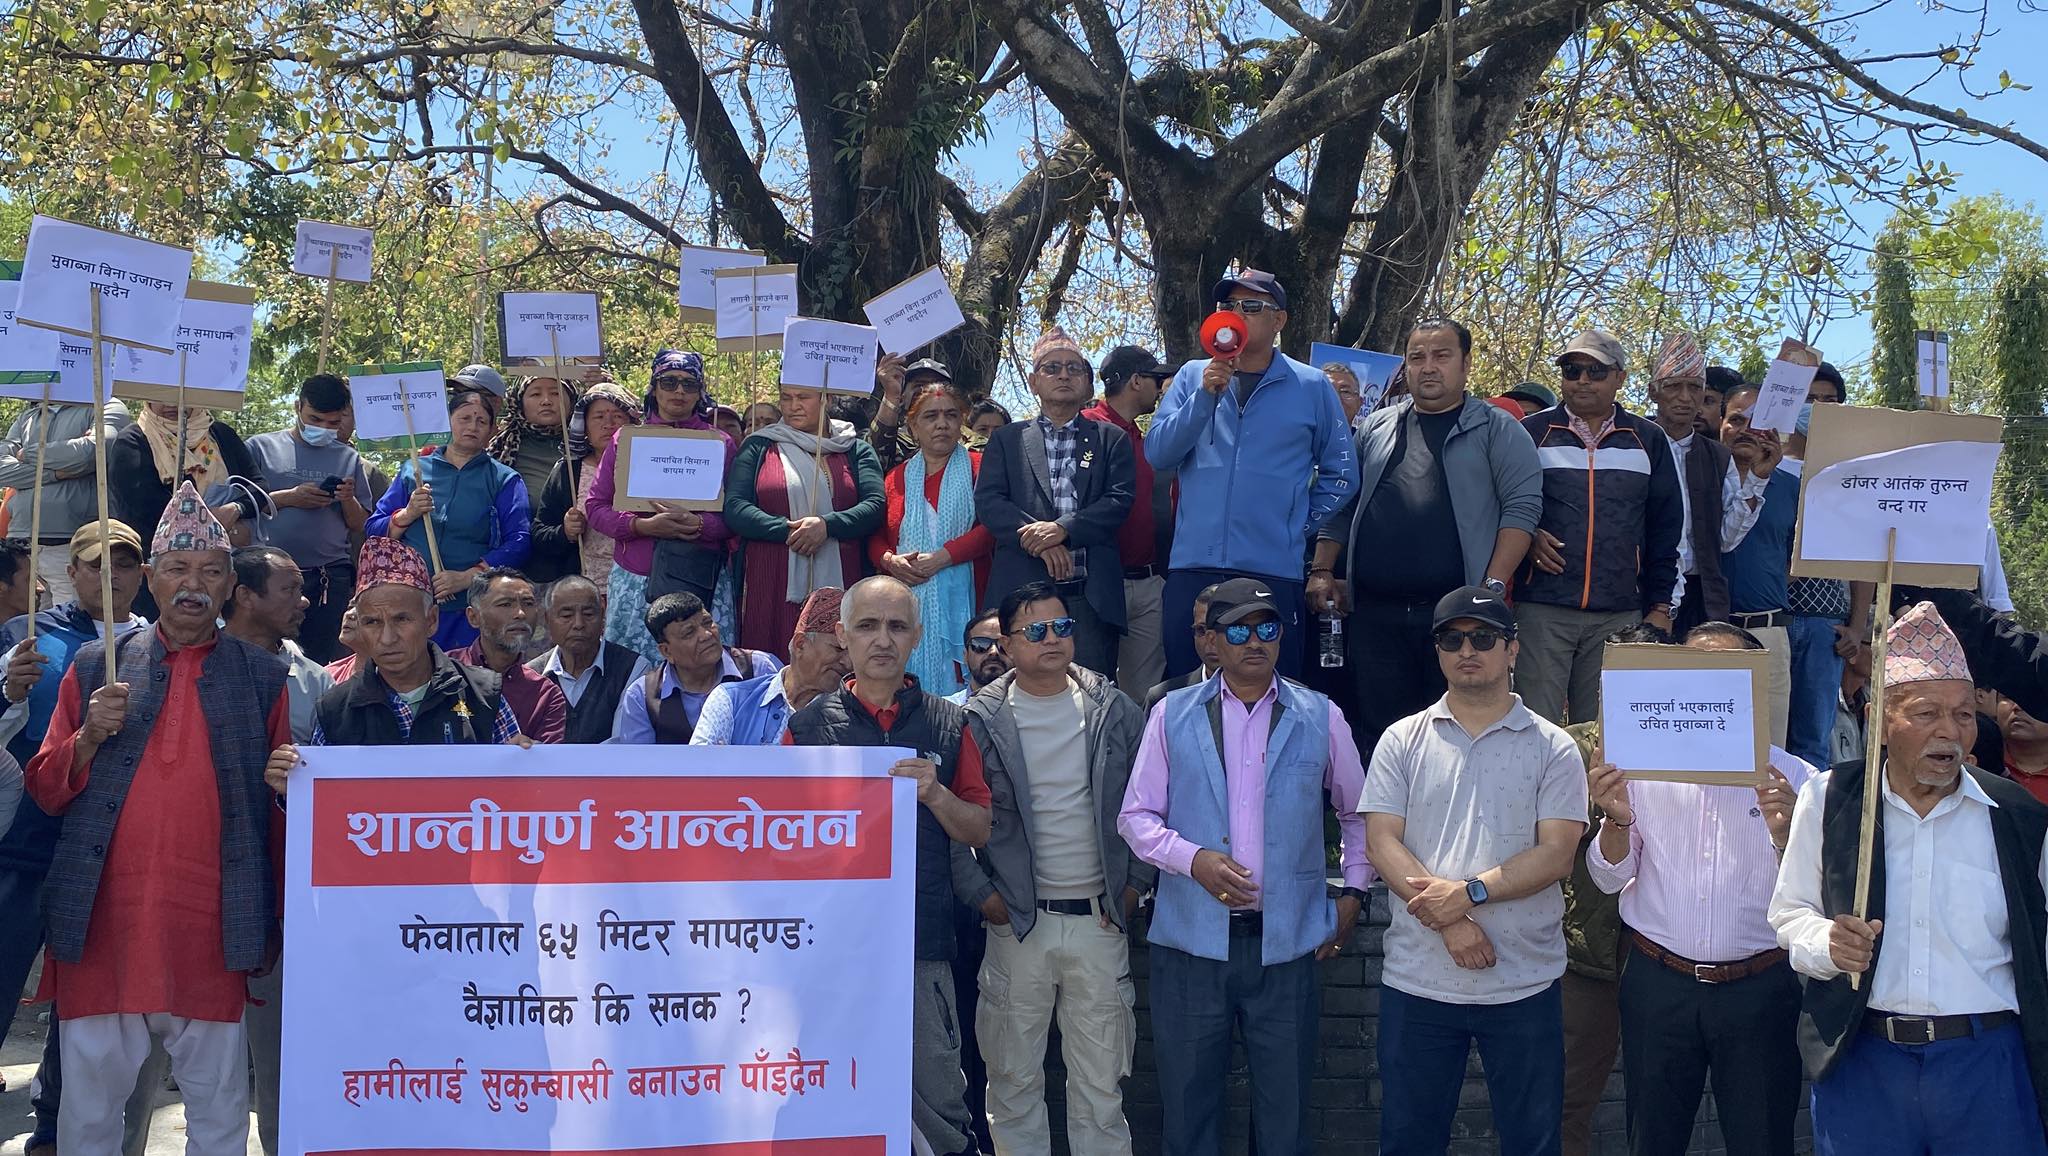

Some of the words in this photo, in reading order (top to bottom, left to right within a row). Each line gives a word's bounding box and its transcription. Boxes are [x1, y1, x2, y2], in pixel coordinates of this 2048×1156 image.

[51, 254, 96, 274] मुवाब्जा
[99, 263, 127, 280] बिना
[193, 328, 234, 341] समाधान
[1883, 474, 1926, 490] आतंक
[1930, 478, 1969, 494] तुरुन्त
[1878, 499, 1904, 513] बन्द
[1908, 500, 1928, 512] गर
[1629, 699, 1675, 715] लालपुर्जा
[1679, 699, 1735, 714] भएकालाई
[1639, 717, 1669, 730] उचित
[1673, 719, 1714, 733] मुवाब्जा
[1717, 716, 1726, 731] दे
[347, 798, 597, 864] शान्तीपुर्ण
[614, 796, 862, 853] आन्दोलन
[400, 914, 524, 955] फेवाताल
[538, 922, 578, 960] ६५
[597, 909, 676, 956] मिटर
[462, 981, 578, 1030] वैज्ञानिक
[592, 982, 635, 1026] कि
[648, 991, 720, 1027] सनक
[737, 988, 751, 1024] ?
[342, 1057, 467, 1108] हामीलाई
[481, 1059, 613, 1113] सुकुम्बासी
[627, 1064, 725, 1097] बनाउन
[739, 1046, 829, 1097] पाँइदैन
